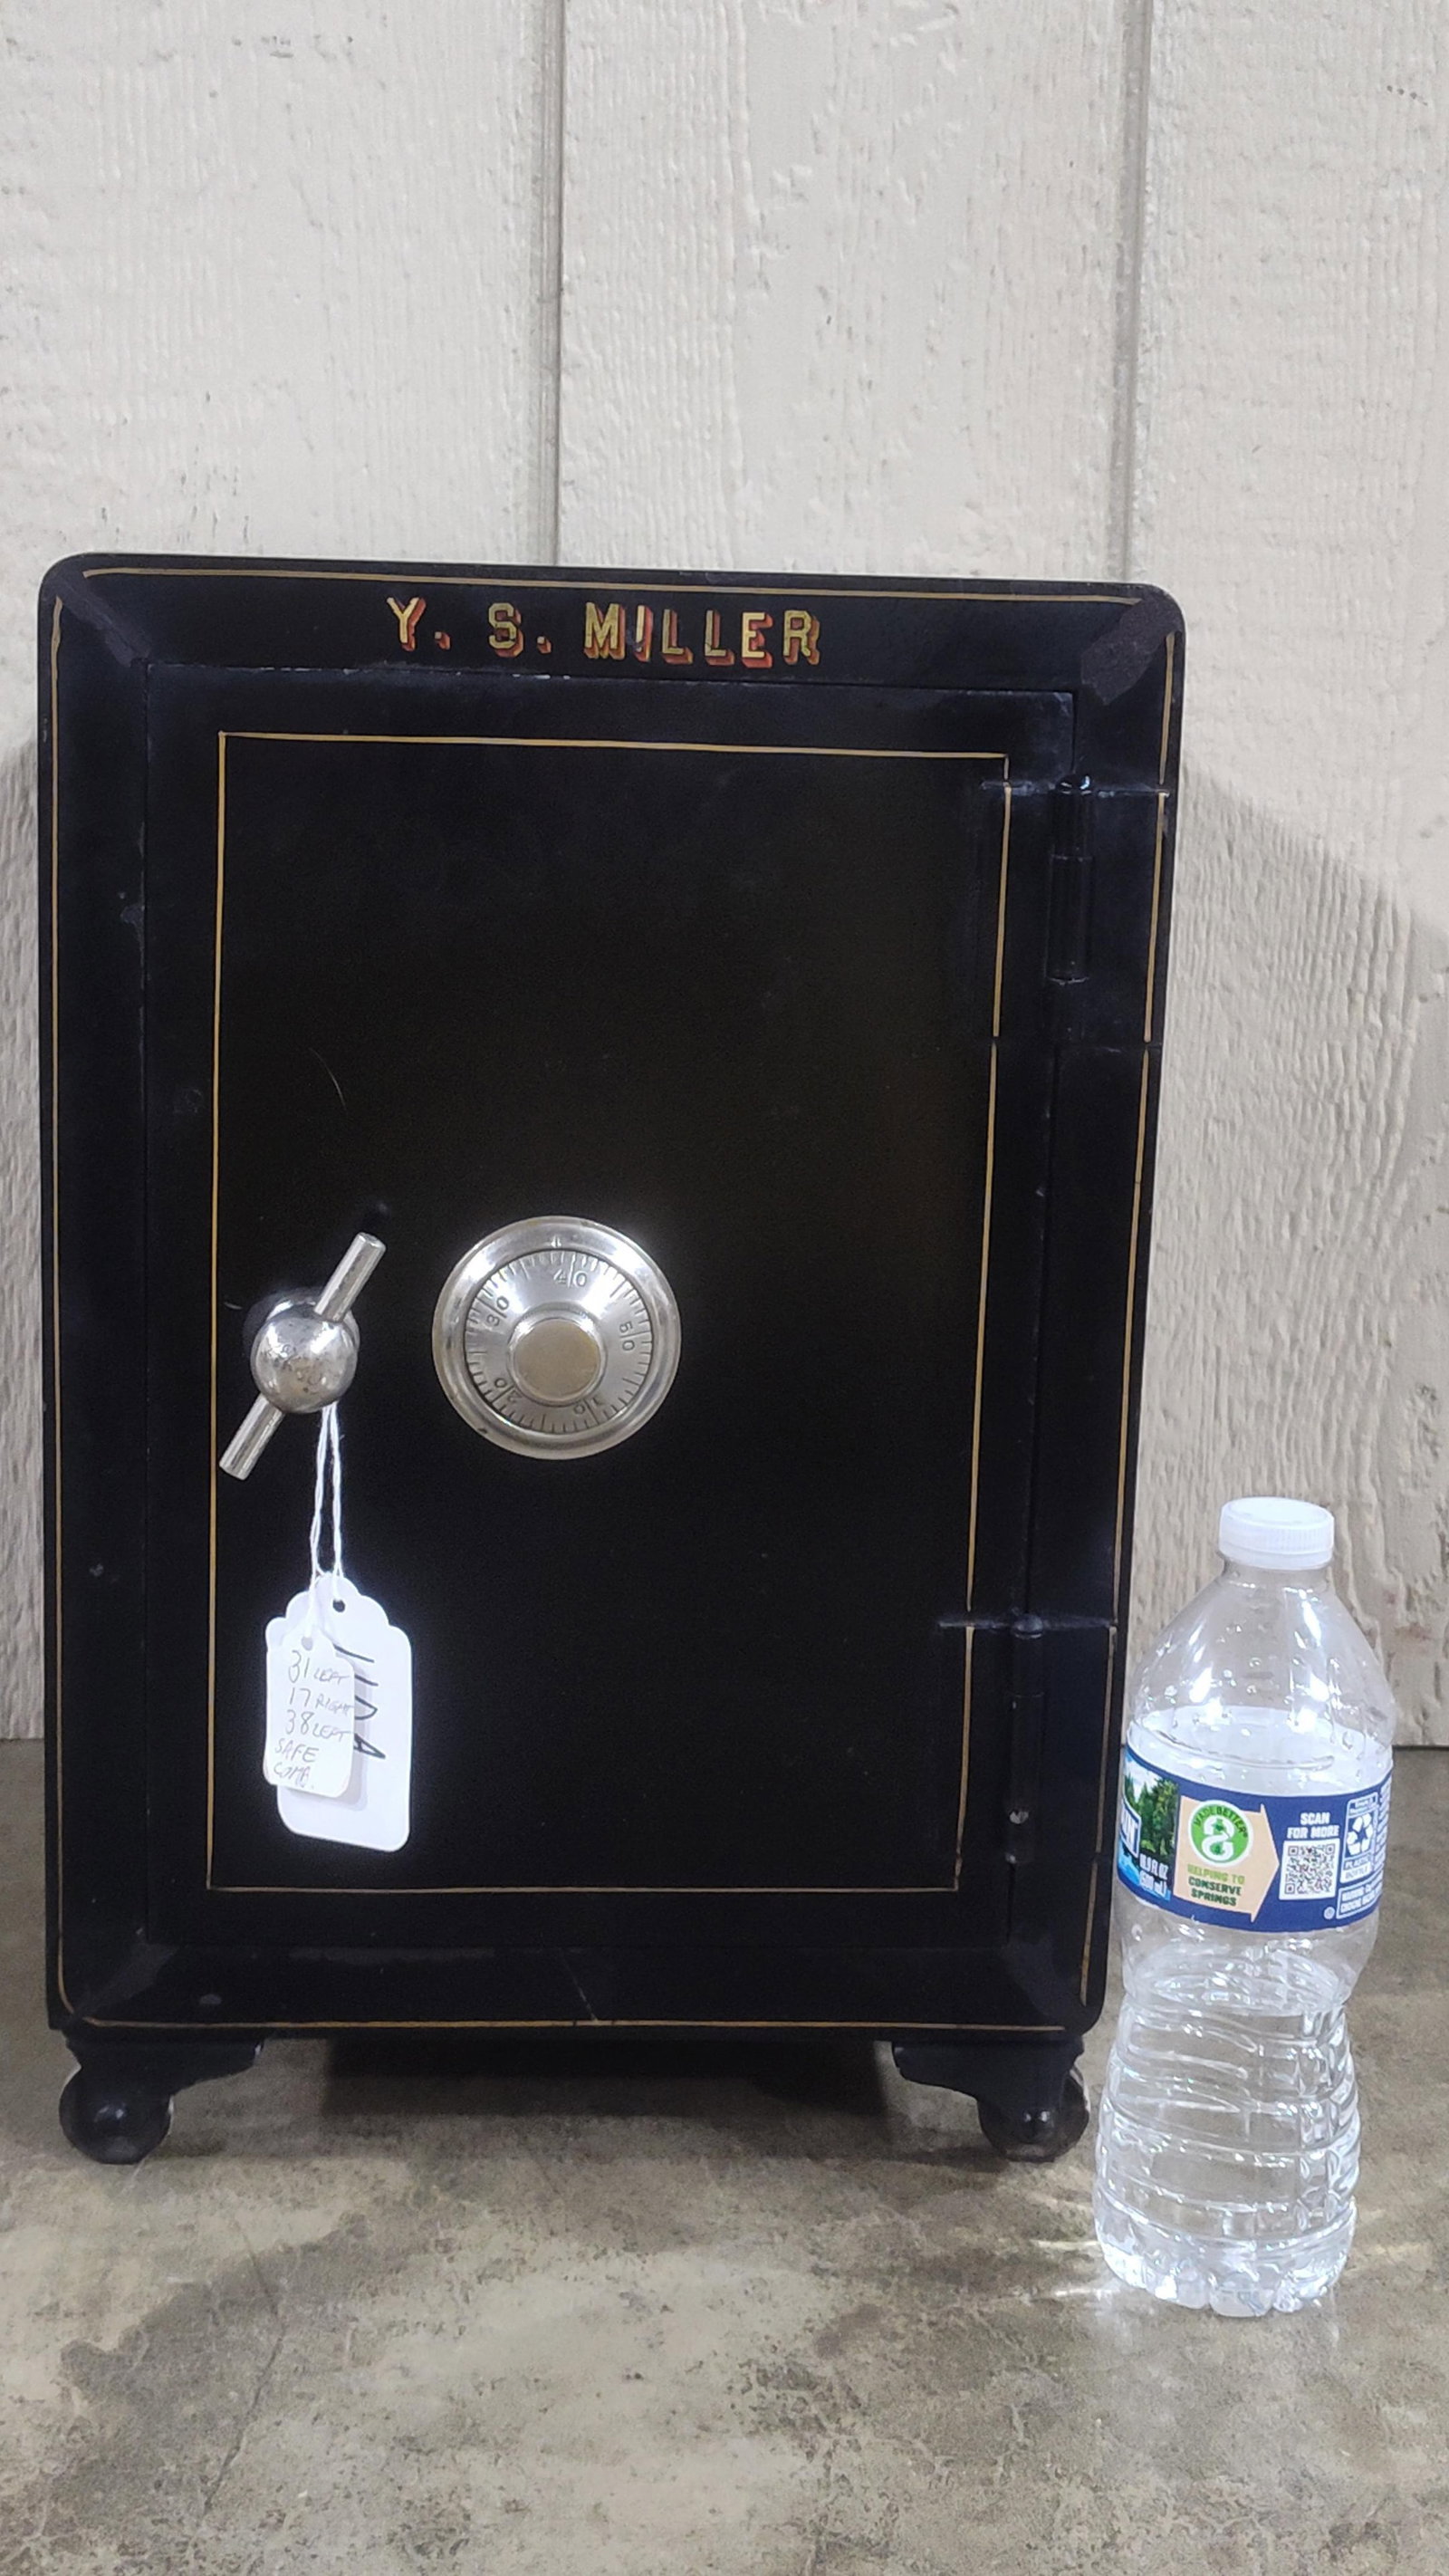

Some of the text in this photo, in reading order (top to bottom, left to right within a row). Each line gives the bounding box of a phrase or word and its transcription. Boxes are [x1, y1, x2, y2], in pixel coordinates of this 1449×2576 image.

[387, 597, 820, 668] Y. S. MILLER
[619, 1321, 635, 1351] 50
[288, 1649, 311, 1684] 31
[289, 1687, 312, 1707] 17
[285, 1708, 315, 1735] 38
[274, 1737, 320, 1764] SAFE
[1300, 1812, 1330, 1825] SCAN
[1287, 1825, 1339, 1839] FOR MORE
[1187, 1864, 1245, 1885] HELPING TO
[1188, 1876, 1242, 1896] CONSERVE
[1191, 1888, 1237, 1907] SPRINGS
